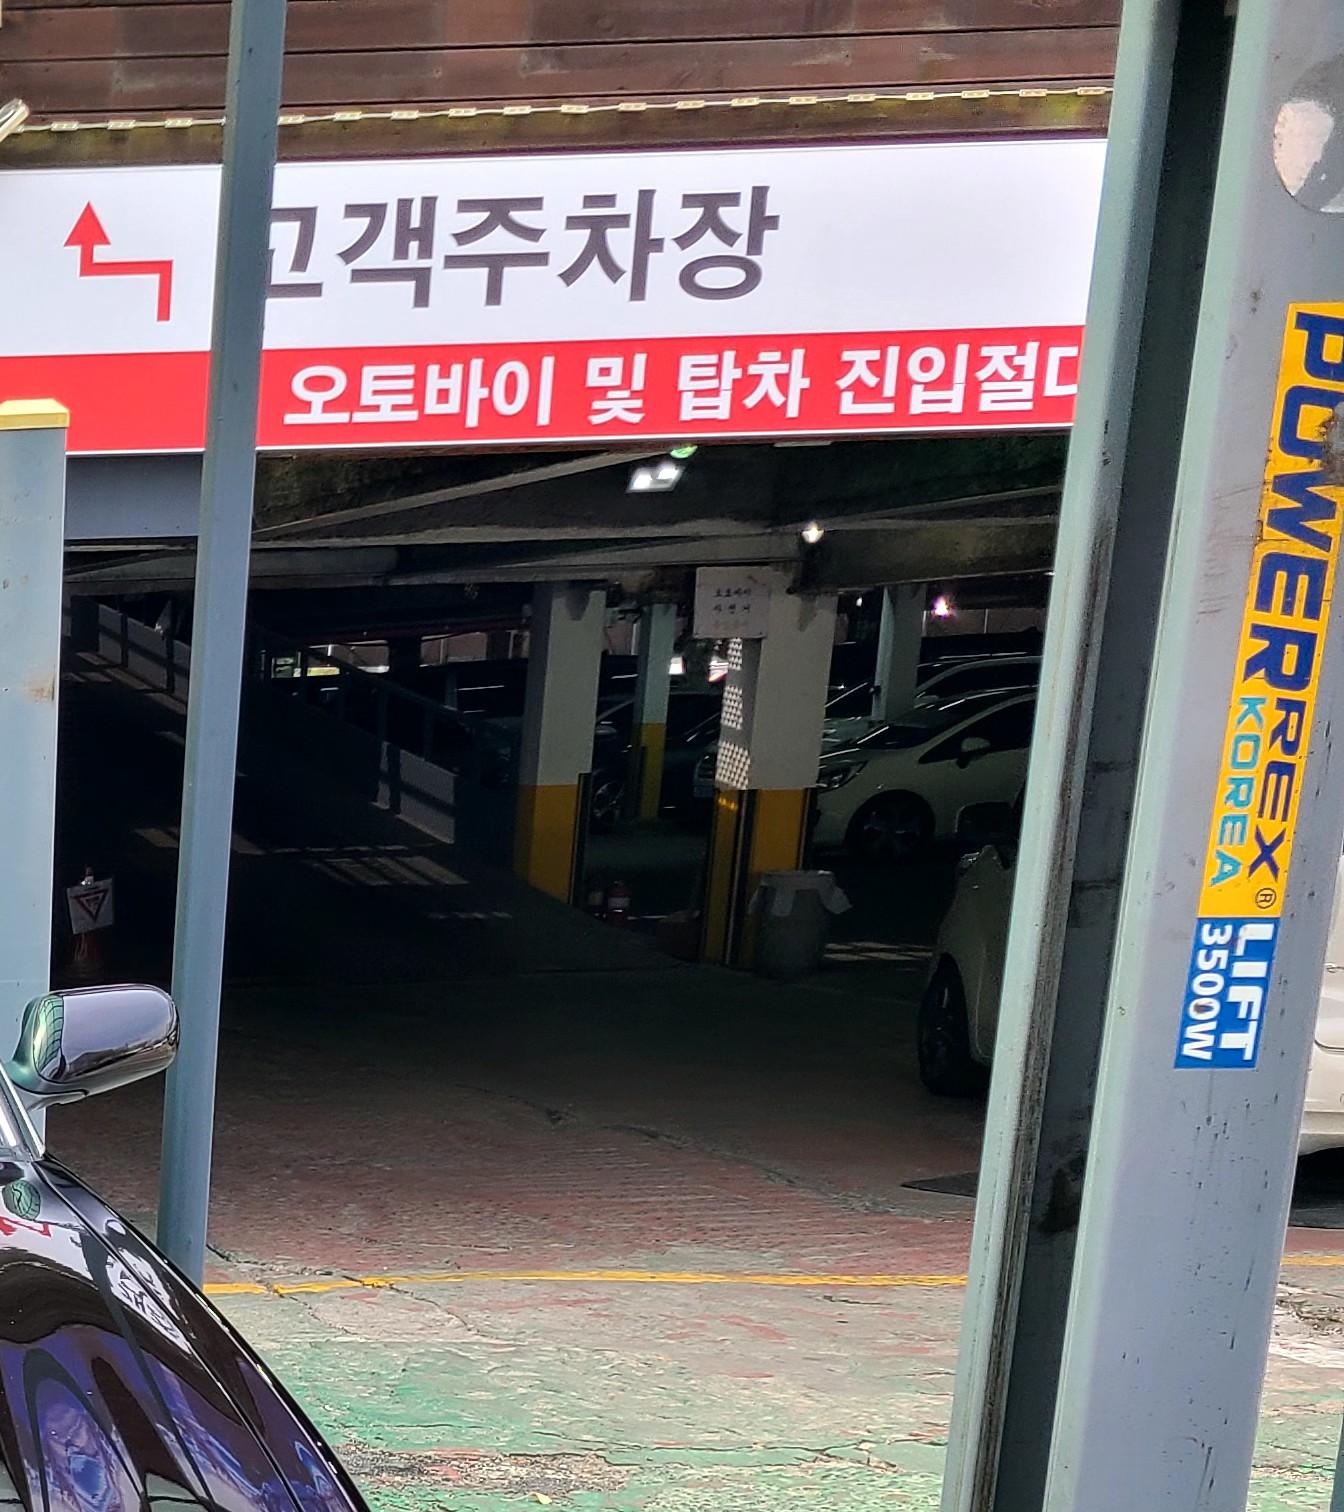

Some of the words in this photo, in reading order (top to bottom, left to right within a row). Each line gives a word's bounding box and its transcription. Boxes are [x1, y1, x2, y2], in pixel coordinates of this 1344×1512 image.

[267, 186, 780, 308] 고객주차장
[283, 356, 555, 427] 오토바이
[585, 353, 647, 424] 및
[678, 347, 810, 420] 탑차
[1209, 696, 1267, 887] KOREA
[1181, 923, 1228, 1060] 3500W
[1218, 922, 1275, 1061] LIFT
